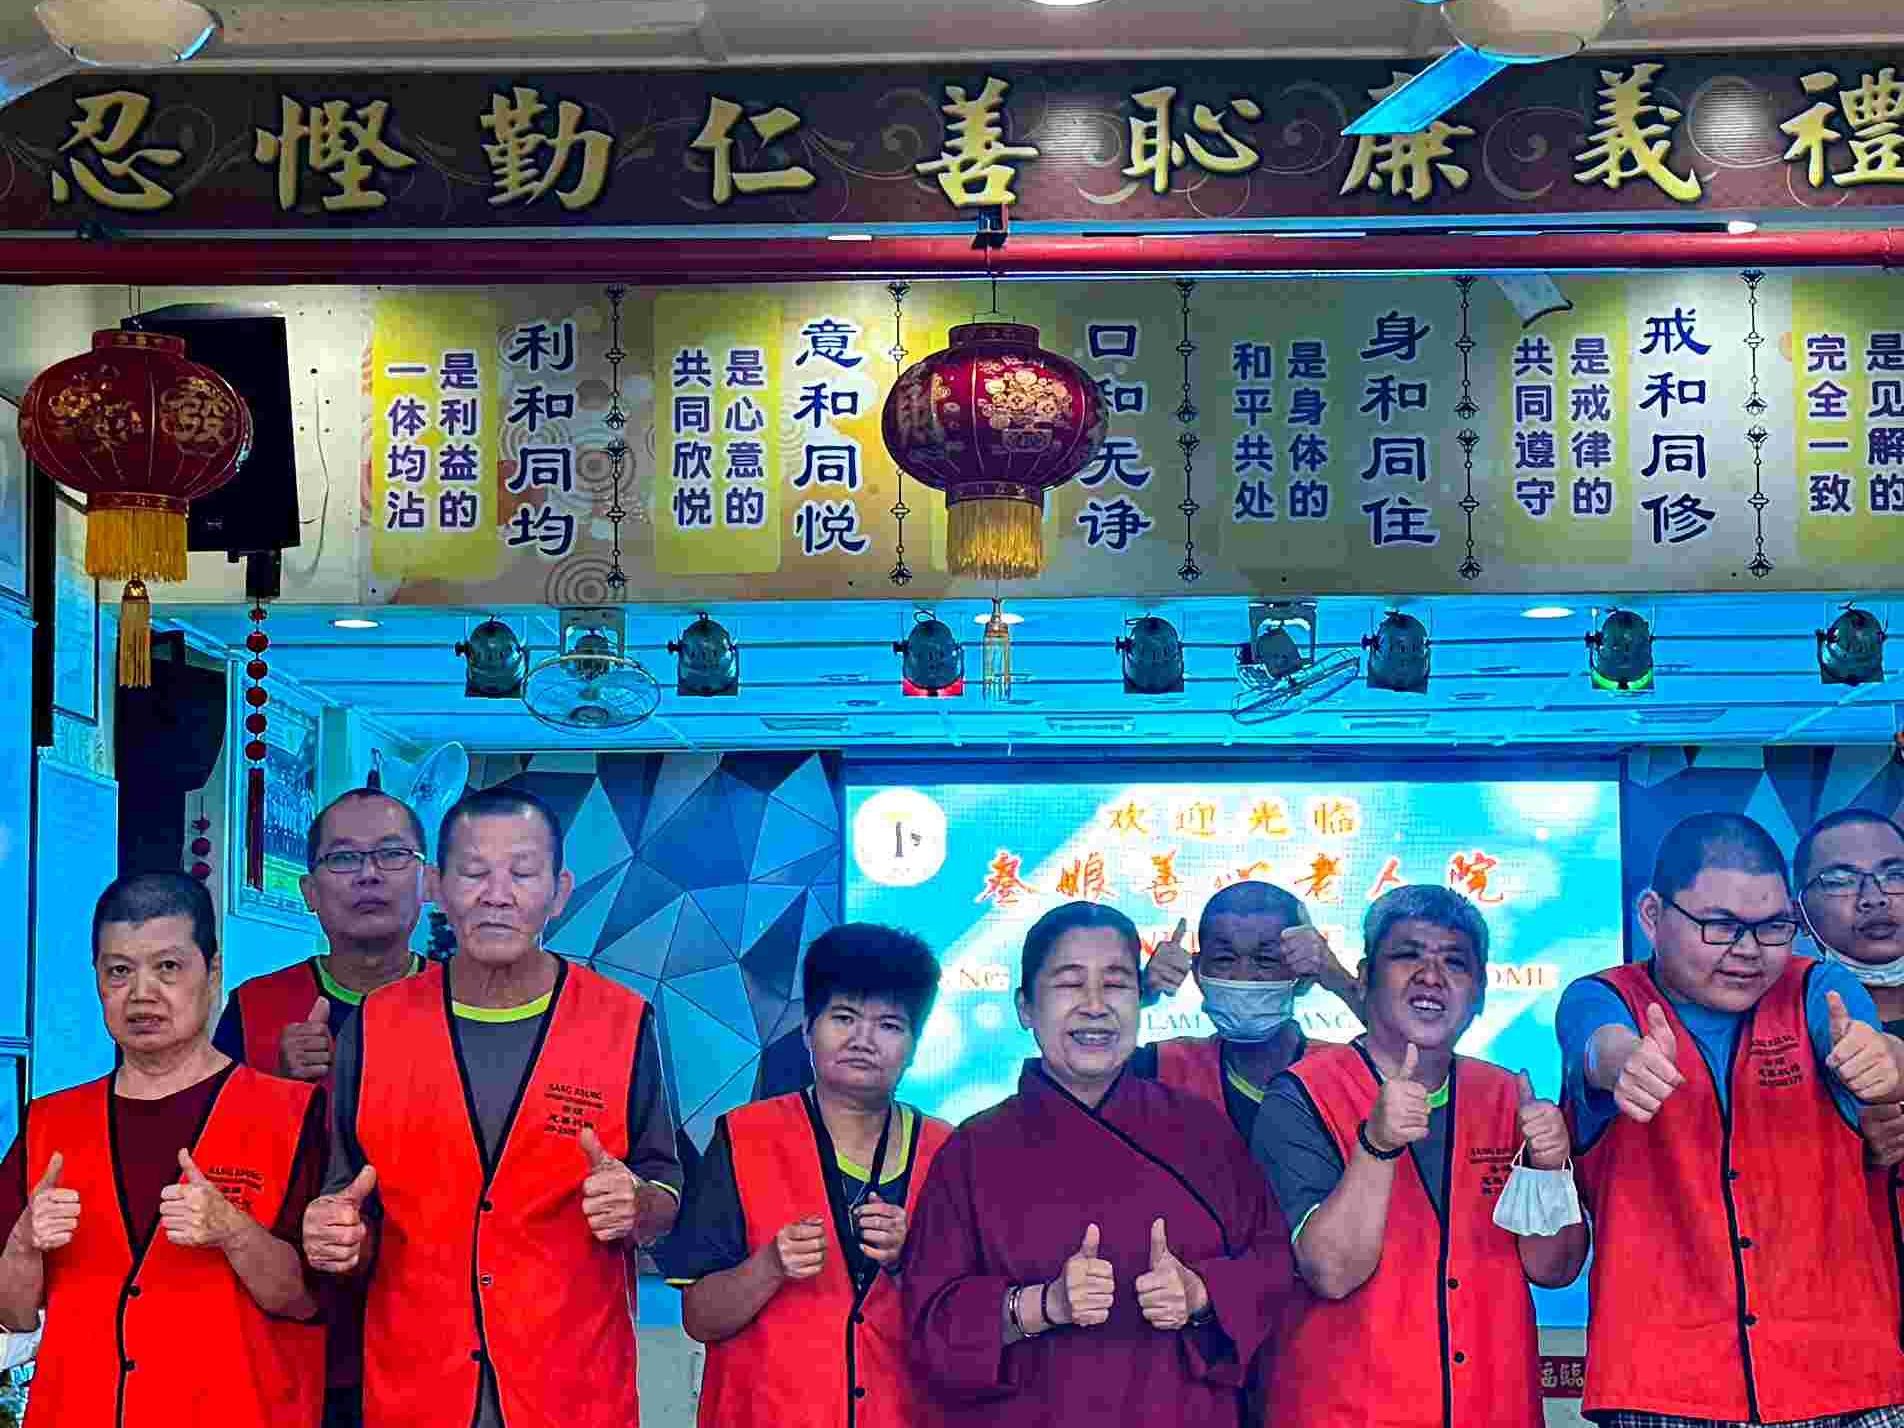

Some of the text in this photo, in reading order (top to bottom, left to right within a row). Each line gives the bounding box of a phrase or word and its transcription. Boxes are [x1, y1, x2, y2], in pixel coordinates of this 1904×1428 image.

[387, 367, 427, 529] 一体均沾
[439, 352, 478, 528] 是利益的
[507, 323, 575, 556] 利和同均
[672, 350, 713, 527] 共同欣悦
[724, 350, 765, 527] 是心意的
[794, 318, 869, 554] 意和同悦
[1233, 341, 1277, 521] 和平共处
[1288, 340, 1329, 520] 是身体的
[1362, 310, 1438, 546] 身和同住
[1514, 336, 1556, 516] 共同遵守
[1570, 337, 1613, 515] 是戒律的
[1638, 308, 1714, 545] 戒和同修
[1806, 334, 1854, 514] 完全一致
